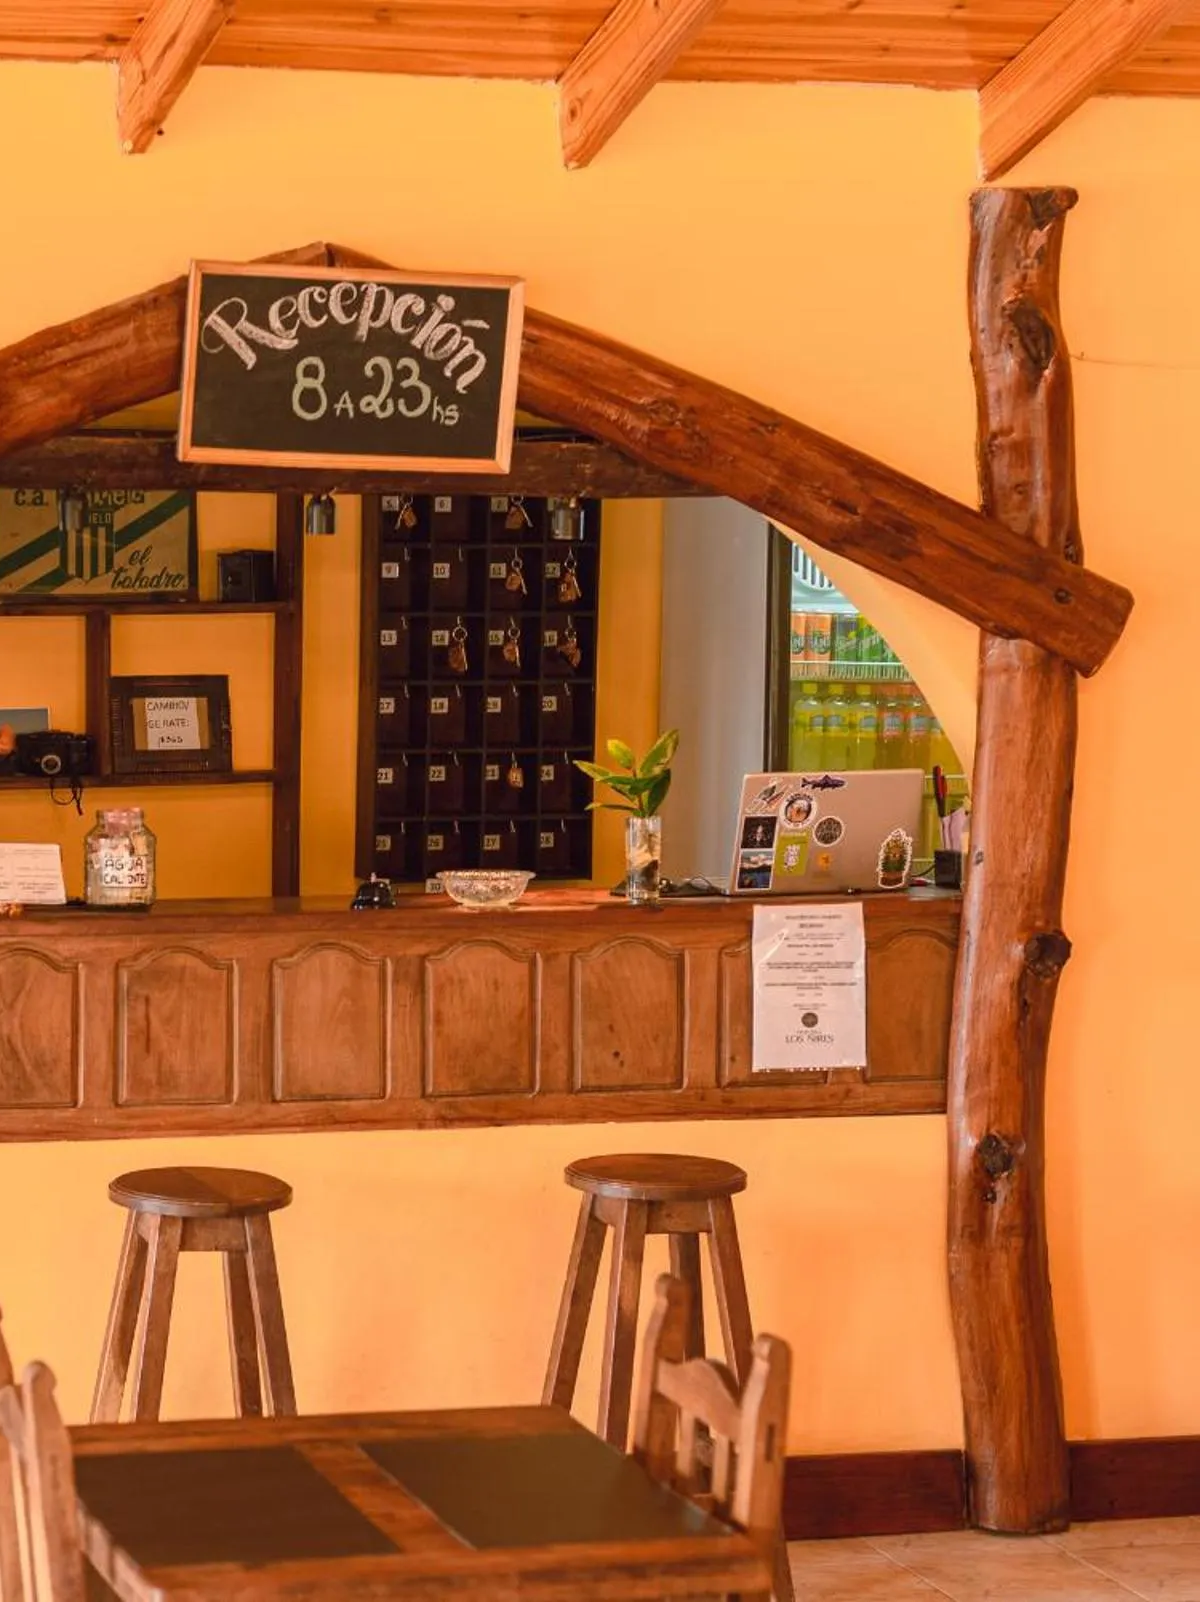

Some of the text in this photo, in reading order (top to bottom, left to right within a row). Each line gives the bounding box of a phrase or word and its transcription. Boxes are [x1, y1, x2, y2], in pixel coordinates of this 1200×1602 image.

[200, 281, 490, 394] Recepción
[292, 356, 328, 421] 8
[128, 545, 153, 566] el
[785, 1034, 805, 1044] LOS
